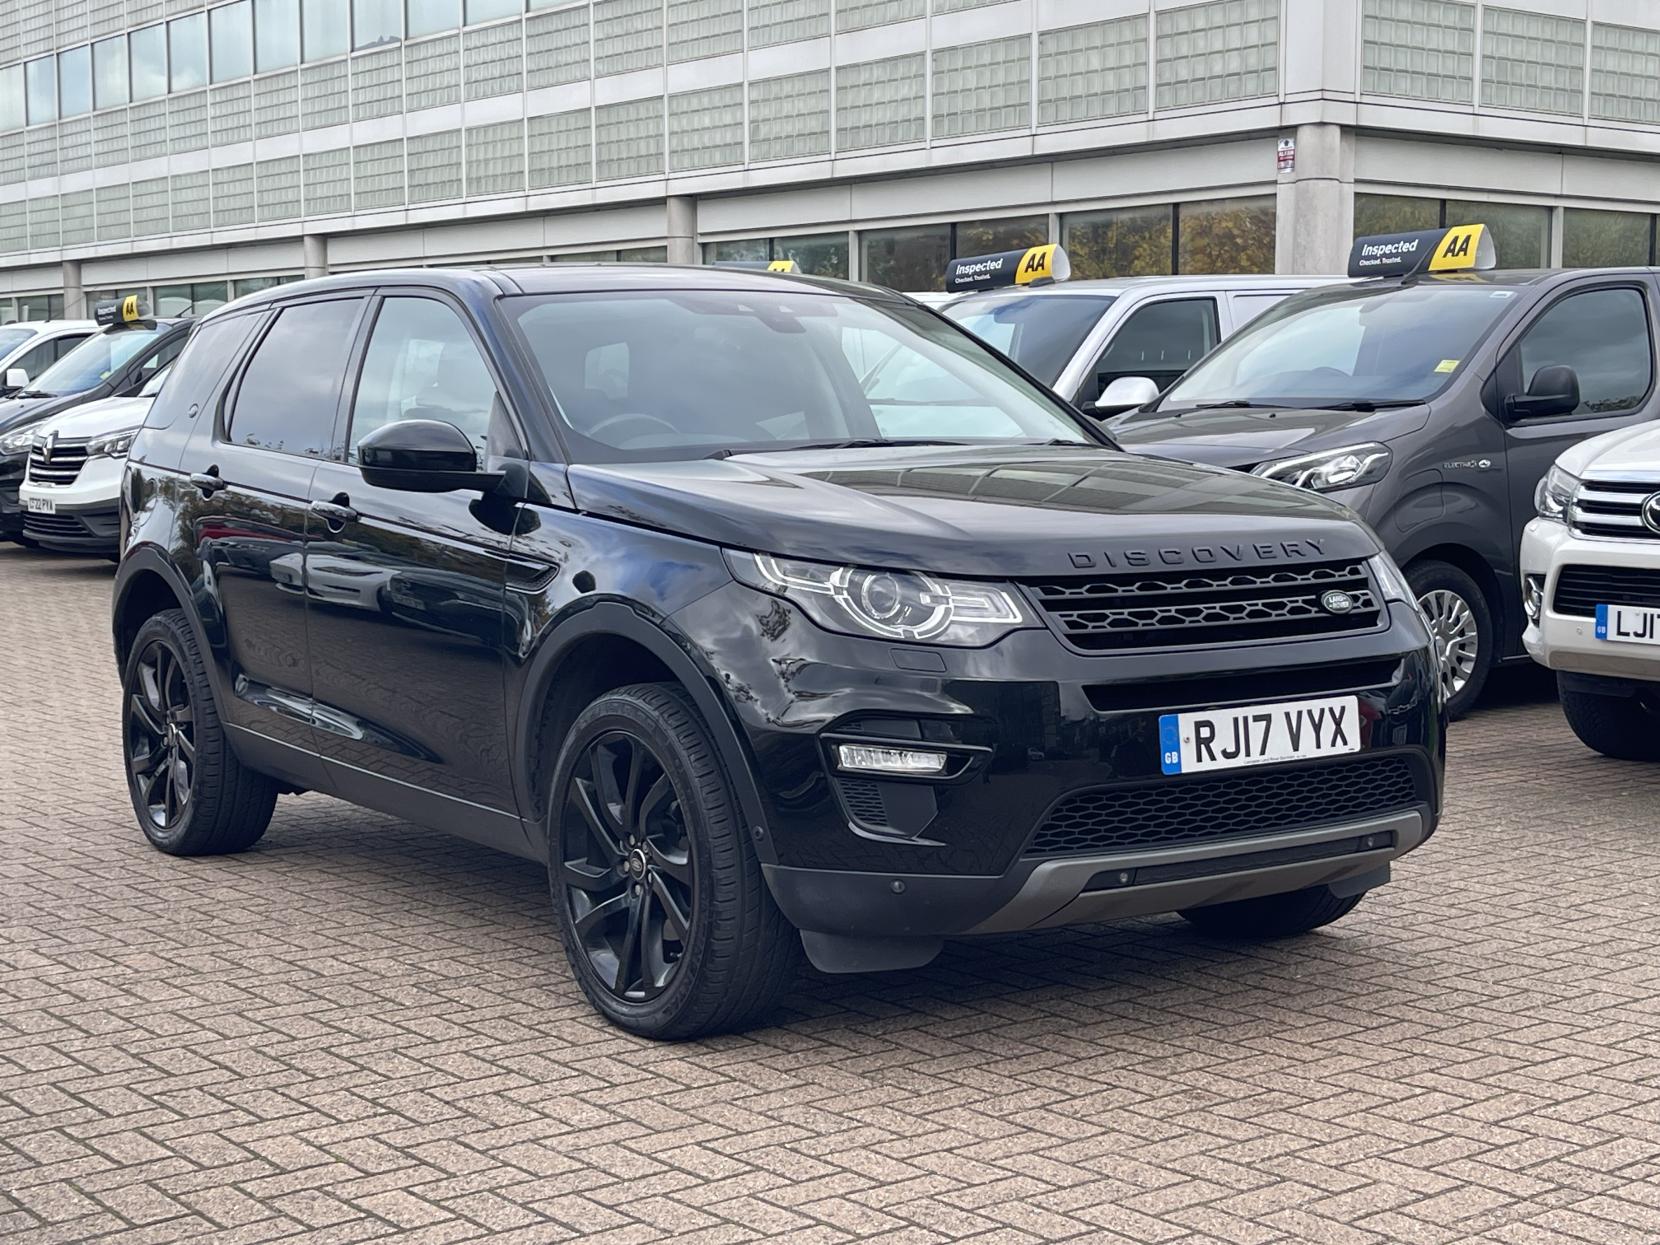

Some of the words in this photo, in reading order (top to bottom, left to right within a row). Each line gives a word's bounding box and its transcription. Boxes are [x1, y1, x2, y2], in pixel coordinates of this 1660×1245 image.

[1362, 239, 1418, 257] Inspected
[1442, 234, 1472, 258] AA
[956, 258, 1003, 276] Inspected
[1024, 252, 1047, 273] AA
[124, 301, 134, 315] AA
[1068, 538, 1326, 569] DISCOVERY
[1616, 611, 1660, 639] LJ1
[1193, 713, 1272, 763] RJ17
[1284, 705, 1348, 752] VYX
[1164, 751, 1178, 765] GB
